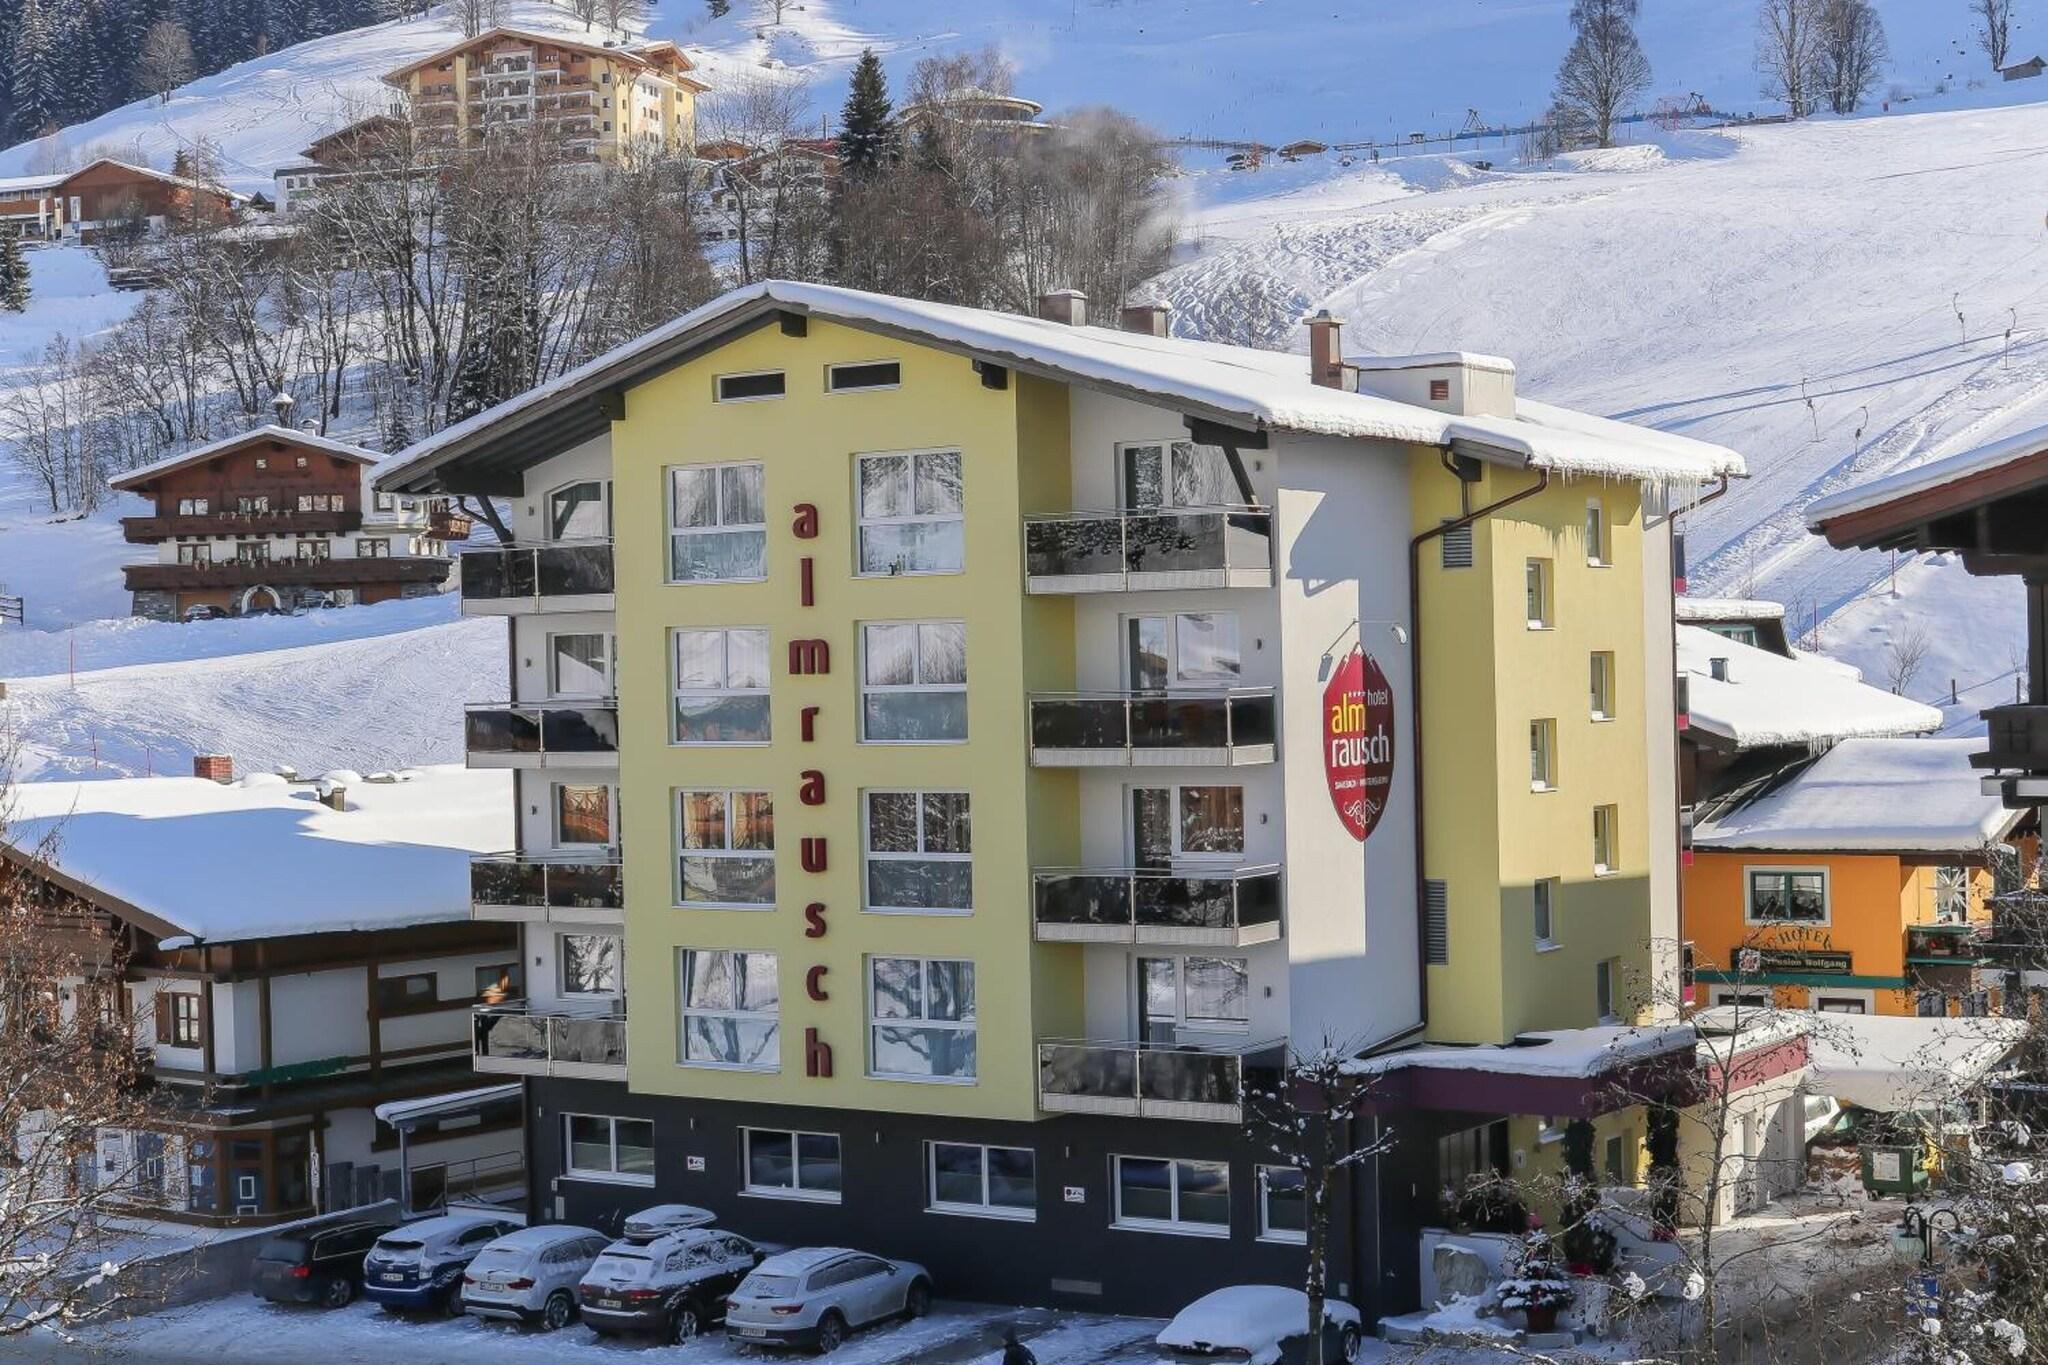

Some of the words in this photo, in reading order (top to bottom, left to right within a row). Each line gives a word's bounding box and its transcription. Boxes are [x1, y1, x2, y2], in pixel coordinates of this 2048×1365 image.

[1331, 692, 1366, 734] alm
[1367, 688, 1388, 706] hotel
[1331, 723, 1390, 768] rausch
